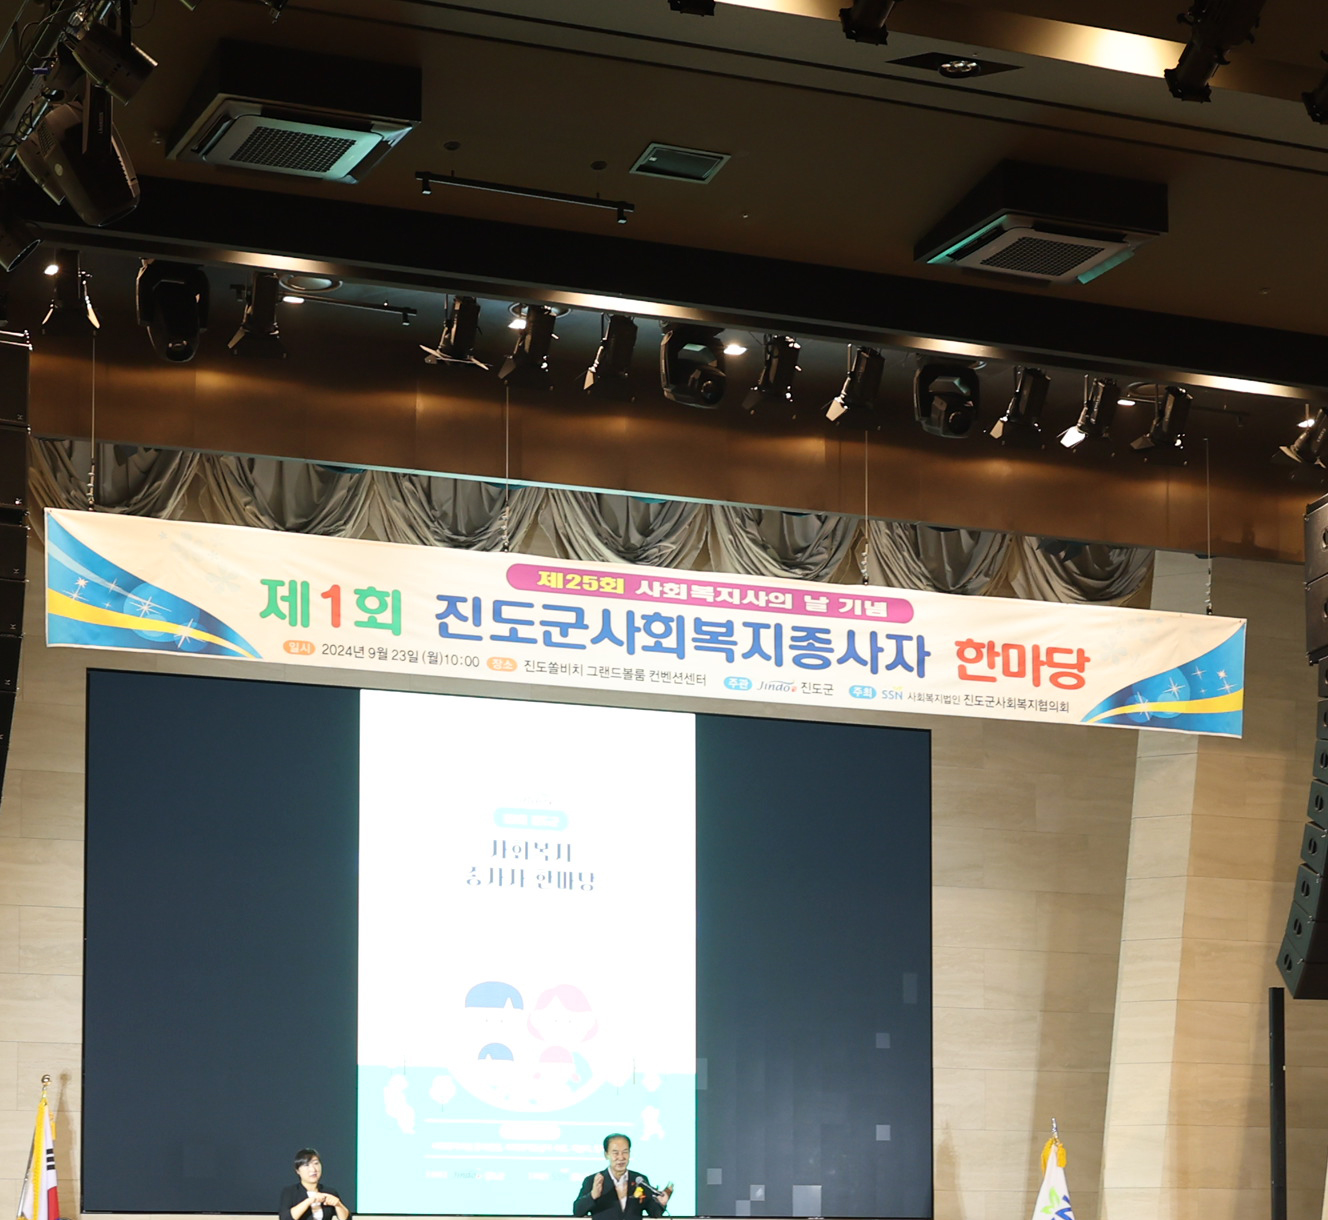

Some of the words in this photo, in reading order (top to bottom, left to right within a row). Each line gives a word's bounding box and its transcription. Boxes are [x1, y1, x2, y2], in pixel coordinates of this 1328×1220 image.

[537, 570, 625, 594] 제25회
[635, 579, 793, 610] 사회복지사의
[804, 594, 830, 613] 날
[838, 598, 889, 618] 기념
[259, 578, 402, 636] 제1회
[435, 594, 932, 679] 진도군사회복지종사자
[954, 638, 1091, 690] 한마당
[288, 640, 312, 654] 일시
[321, 643, 366, 659] 2024년
[368, 646, 389, 661] 9월
[391, 649, 419, 664] 23일
[491, 658, 514, 671] 장소
[524, 659, 584, 677] 진도쏠비치
[586, 665, 646, 683] 그랜드볼룸
[649, 669, 707, 686] 컨벤션센터
[727, 677, 750, 690] 주관
[800, 682, 835, 696] 진도군
[881, 690, 904, 701] SSN
[907, 691, 961, 706] 사회복지법인
[963, 693, 1070, 714] 진도군사회복지협의회
